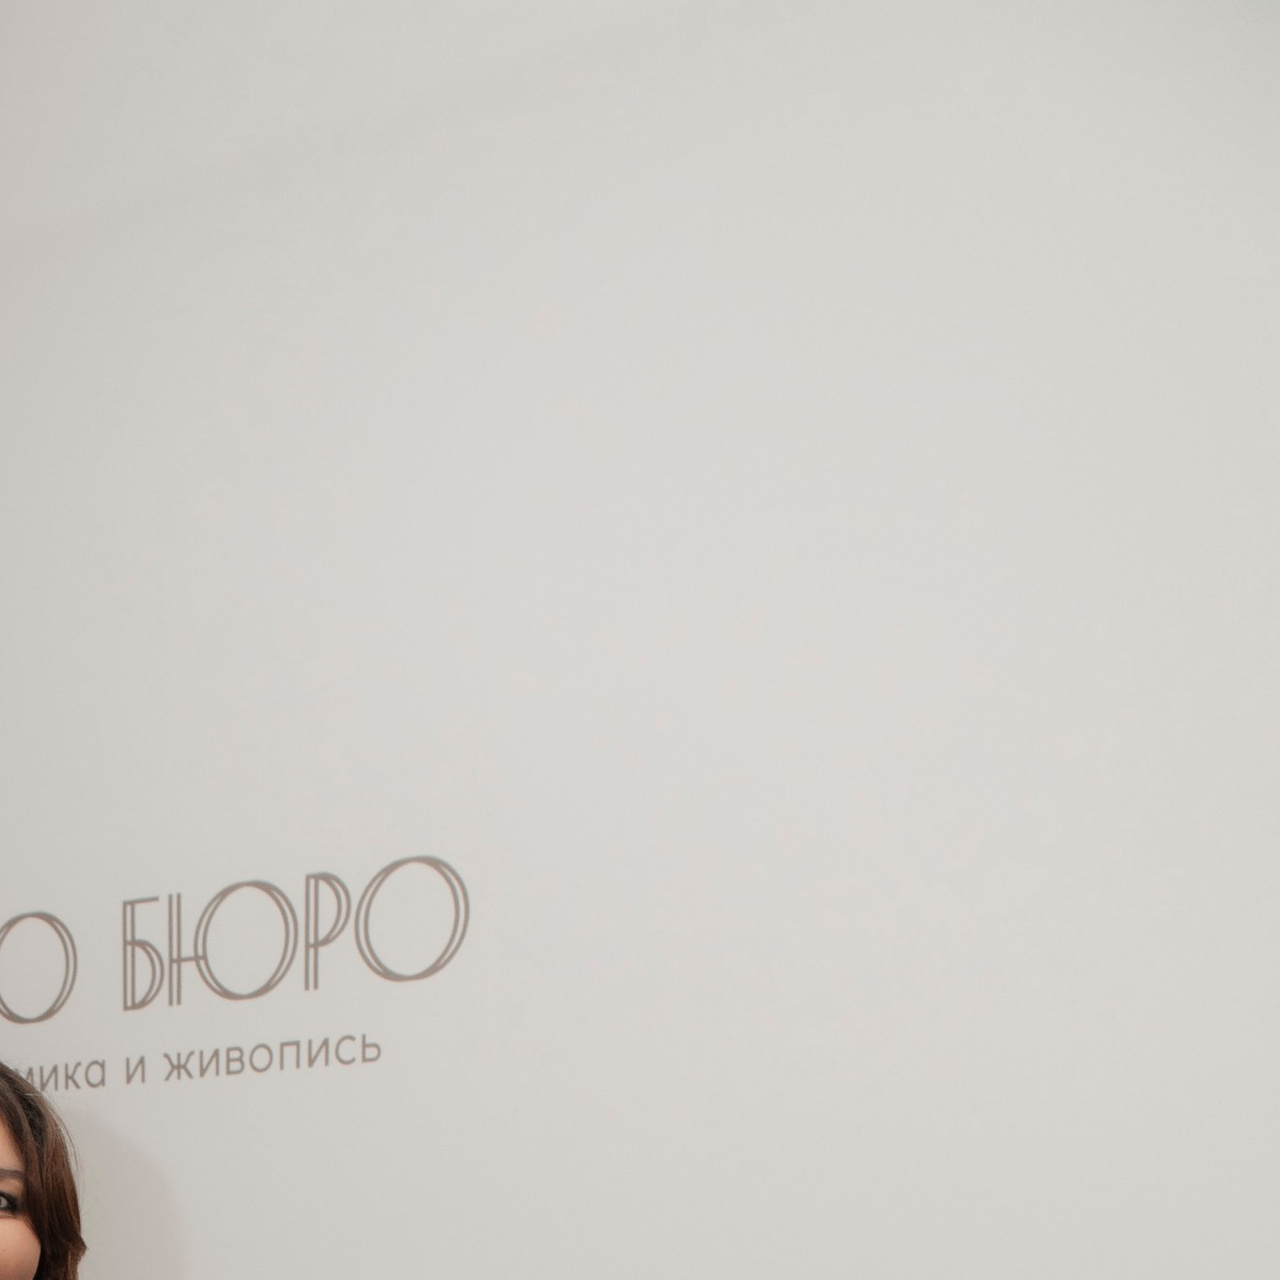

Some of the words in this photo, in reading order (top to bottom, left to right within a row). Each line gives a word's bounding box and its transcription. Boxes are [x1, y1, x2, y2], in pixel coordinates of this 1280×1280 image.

[122, 855, 470, 1012] БЮРО
[125, 1054, 146, 1085] и
[163, 1032, 382, 1083] живопись
